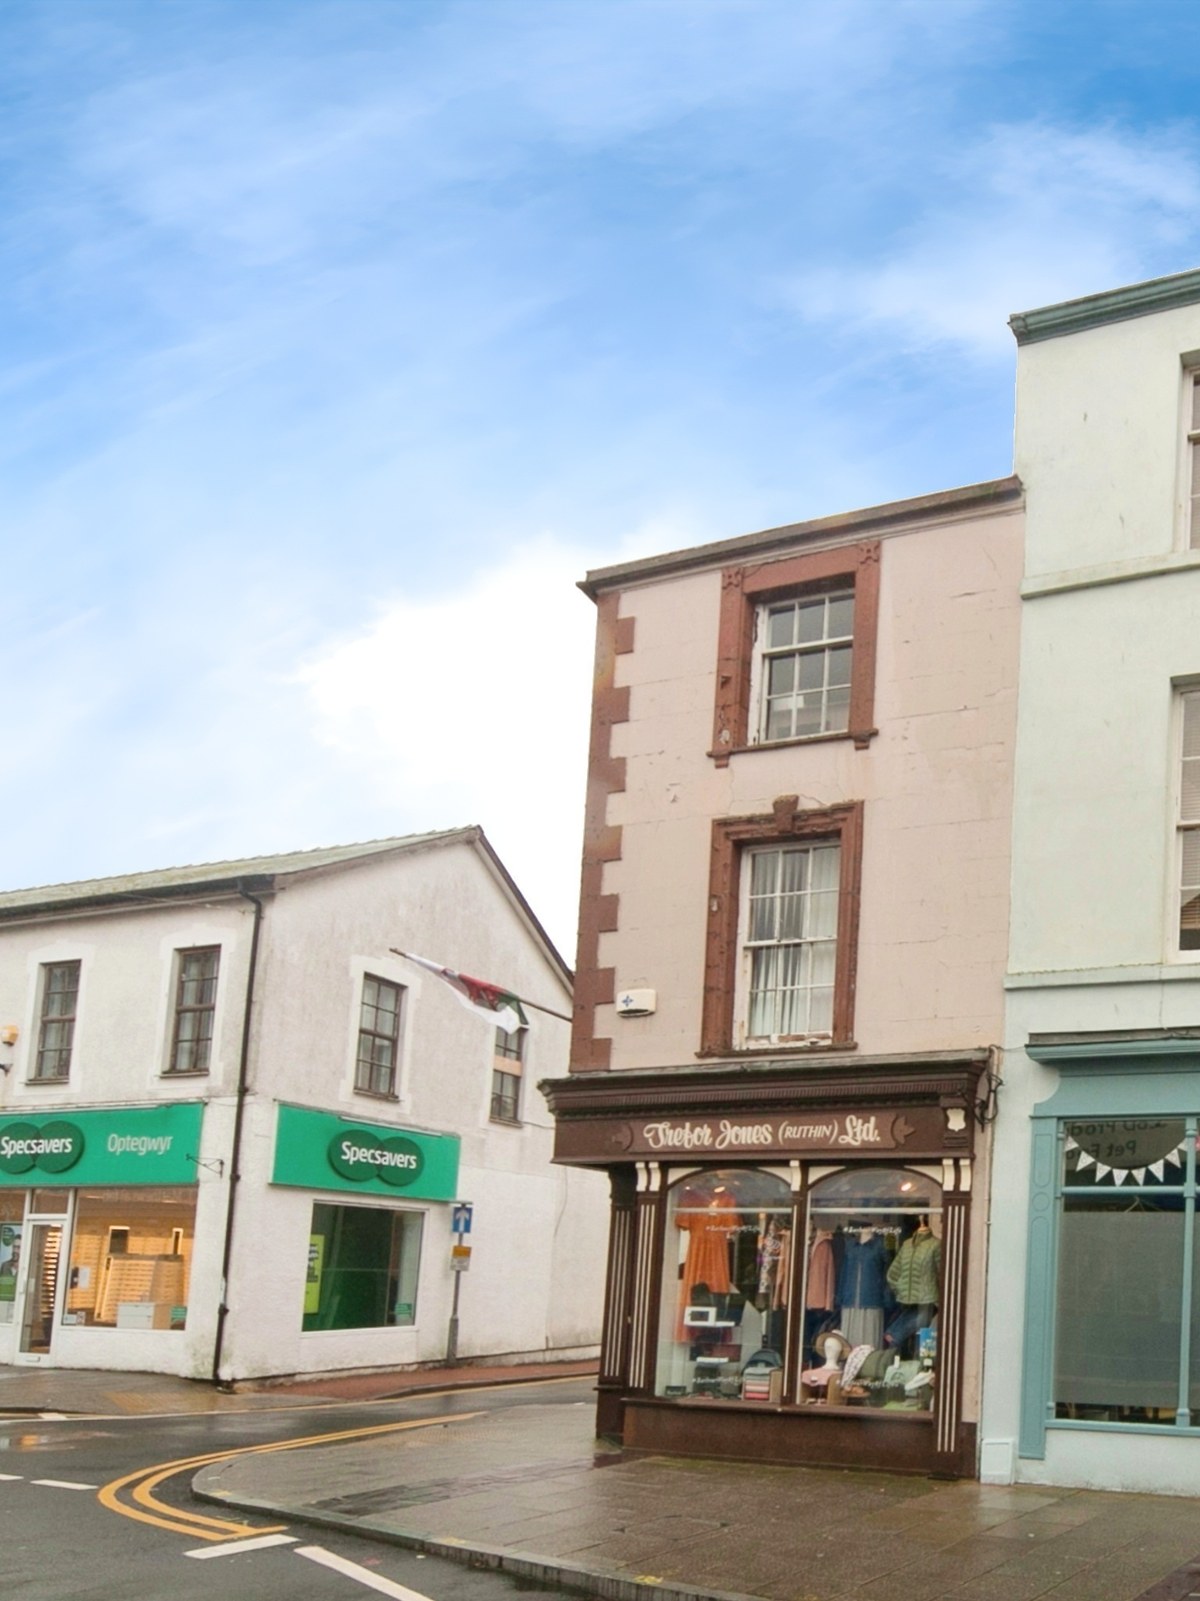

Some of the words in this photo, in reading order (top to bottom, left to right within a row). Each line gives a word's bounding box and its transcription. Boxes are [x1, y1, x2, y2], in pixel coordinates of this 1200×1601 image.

[1, 1136, 73, 1158] Specsavers
[108, 1133, 173, 1155] Optegwyr
[643, 1121, 713, 1149] Trefor
[715, 1119, 773, 1149] Jones
[778, 1119, 839, 1145] (RUTHIN)
[838, 1114, 881, 1146] Ltd.
[341, 1141, 417, 1169] Specsavers
